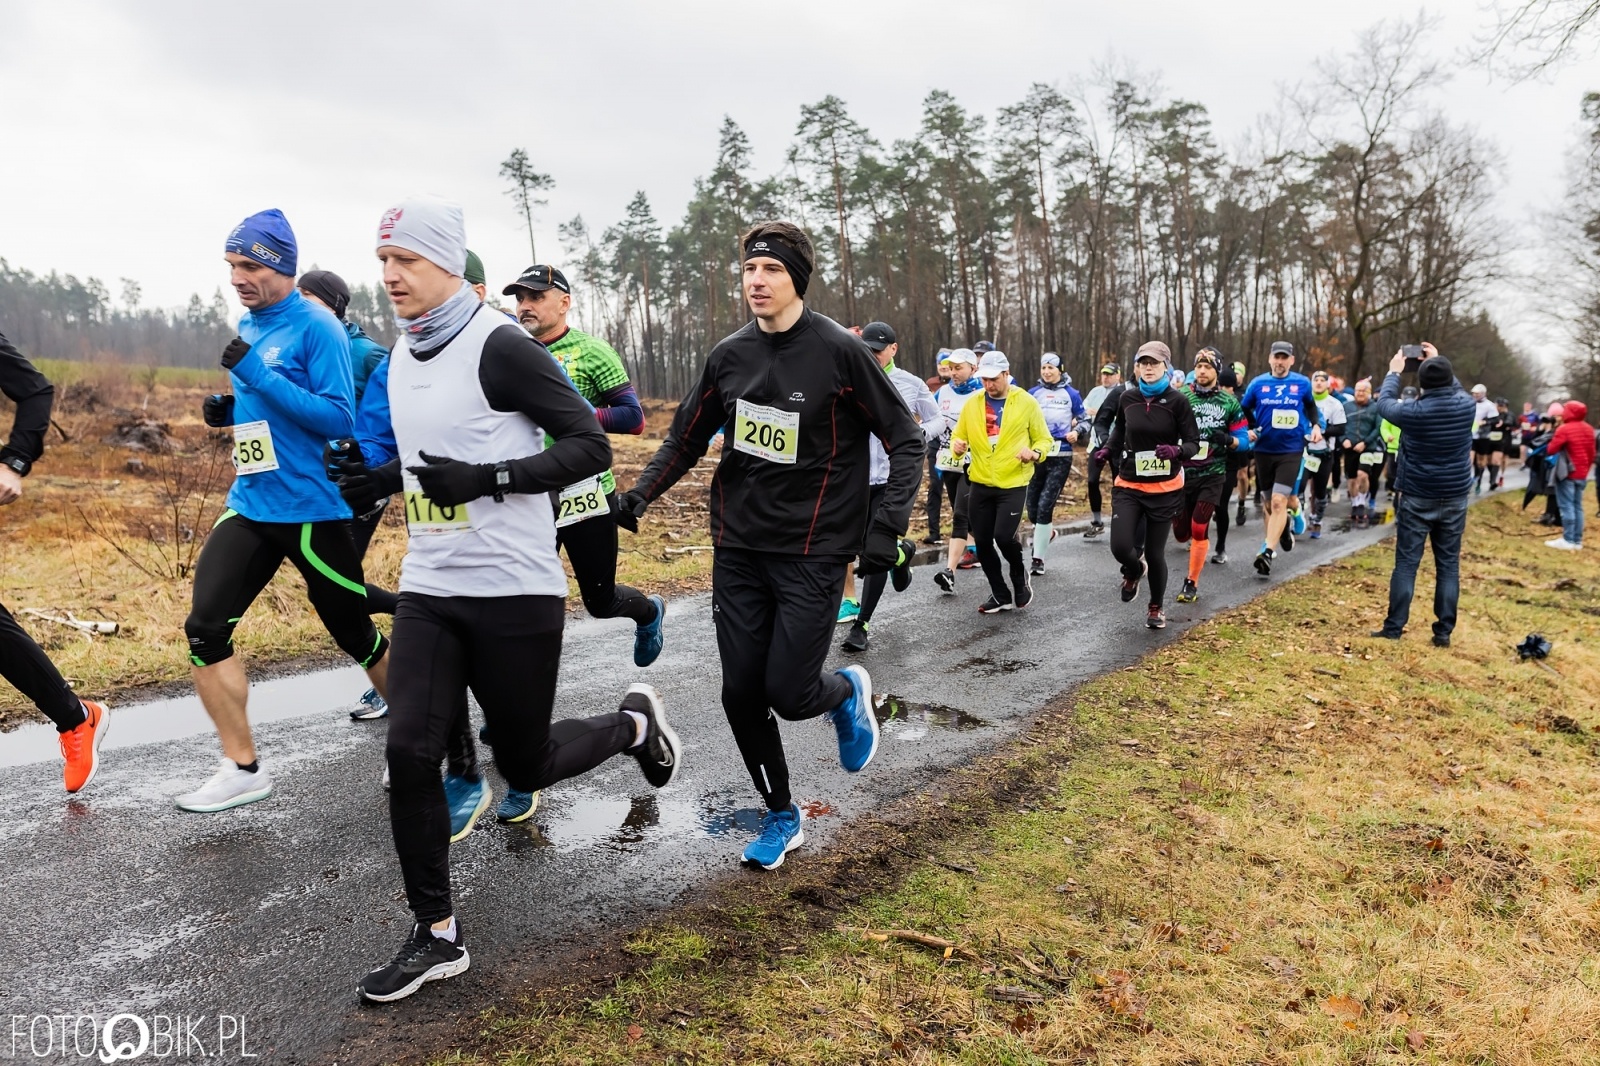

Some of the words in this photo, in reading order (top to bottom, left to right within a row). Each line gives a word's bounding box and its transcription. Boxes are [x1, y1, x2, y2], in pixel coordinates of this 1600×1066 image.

[1276, 416, 1295, 425] 212
[744, 420, 786, 452] 206
[238, 439, 264, 464] 58
[1141, 459, 1166, 471] 244
[560, 492, 599, 517] 258
